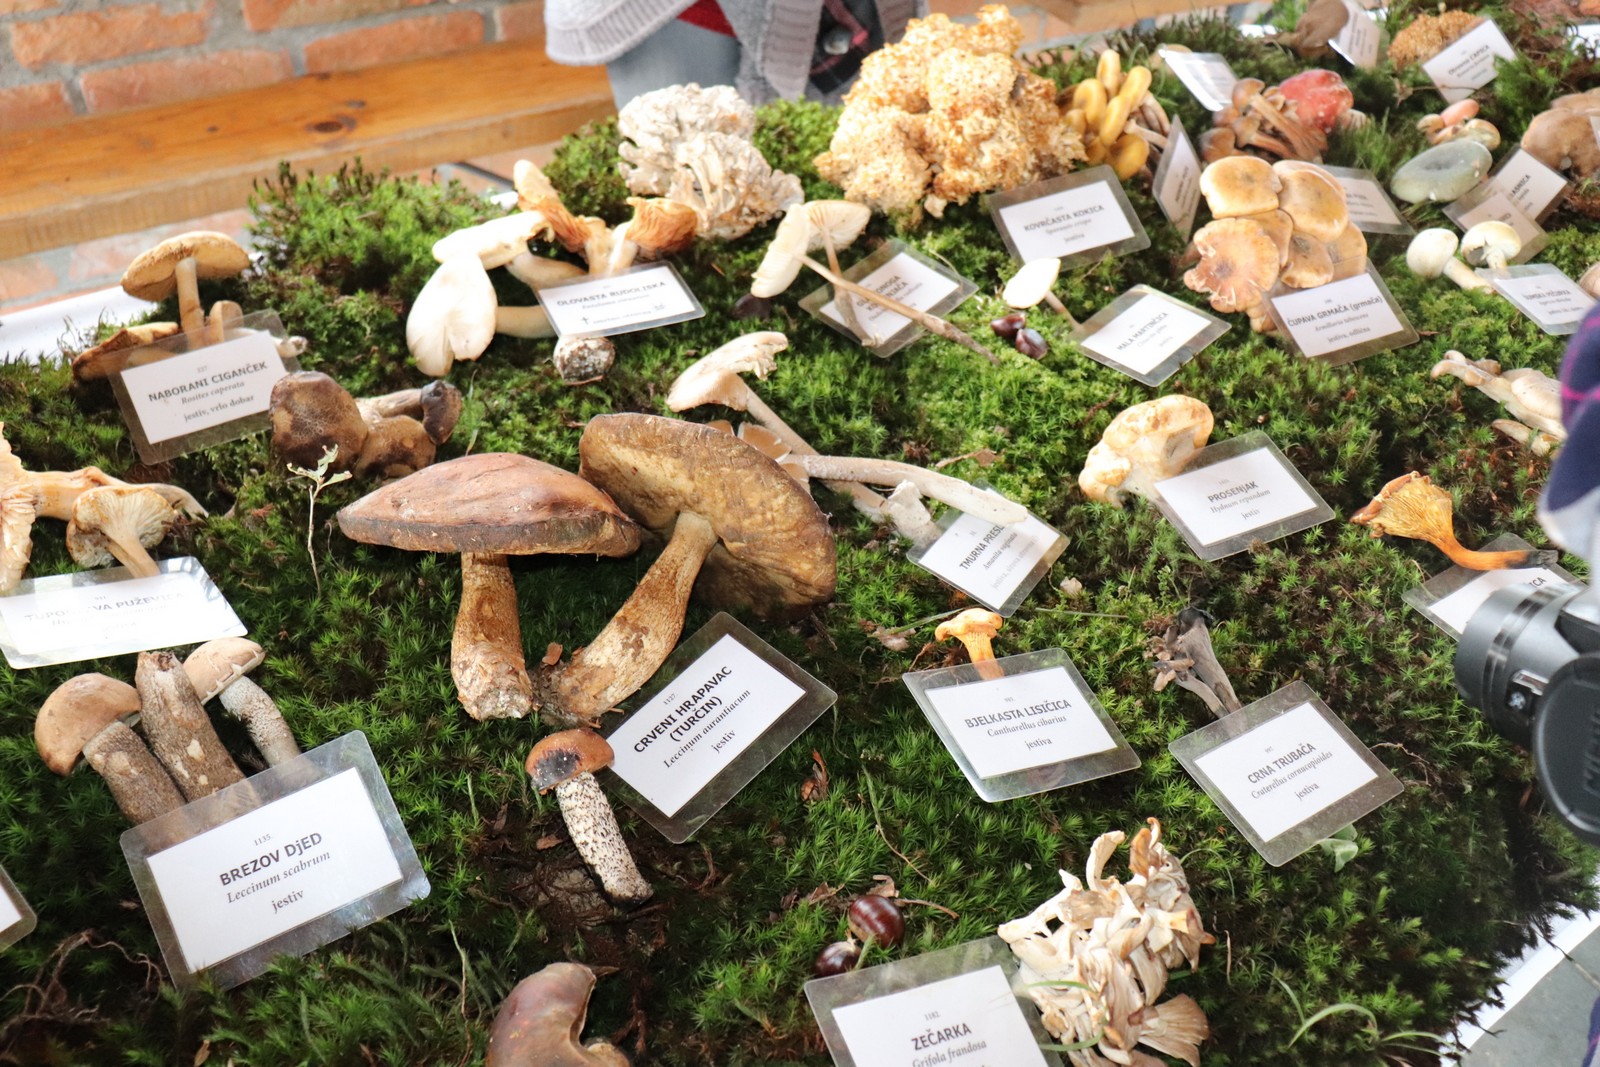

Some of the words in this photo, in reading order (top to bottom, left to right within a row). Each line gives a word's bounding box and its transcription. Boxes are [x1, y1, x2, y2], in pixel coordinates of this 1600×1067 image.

[1317, 304, 1350, 319] GRMAČA
[1350, 296, 1384, 312] (grmača)
[148, 380, 209, 402] NABORANI
[212, 361, 268, 384] CIGANČEK
[184, 410, 210, 423] jestiv,
[959, 542, 989, 570] TMURNA
[634, 714, 678, 753] CRVENI
[675, 666, 732, 716] HRAPAVAC
[669, 696, 722, 742] (TURČIN)
[964, 710, 1024, 728] BJELKASTA
[1024, 700, 1072, 716] LISIČICA
[664, 734, 702, 768] Leccinum
[702, 689, 751, 735] aurantiacum
[988, 720, 1036, 737] Cantharellus
[1037, 715, 1067, 728] cibarius
[712, 730, 736, 754] jestiv
[1025, 737, 1052, 750] jestiva
[1248, 764, 1276, 784] CRNA
[1272, 743, 1316, 770] TRUBAČA
[1252, 776, 1288, 799] Craterellus
[1287, 751, 1333, 780] cornucopioides
[1294, 782, 1320, 802] jestiva
[254, 834, 271, 846] 1135
[219, 850, 280, 886] BREZOV
[284, 832, 322, 857] DjED
[226, 874, 280, 904] Leccinum
[283, 852, 330, 878] scabrum
[272, 889, 304, 914] jestiv
[911, 1022, 972, 1051] ZEČARKA
[912, 1053, 946, 1067] Grifola
[948, 1040, 987, 1063] frandosa
